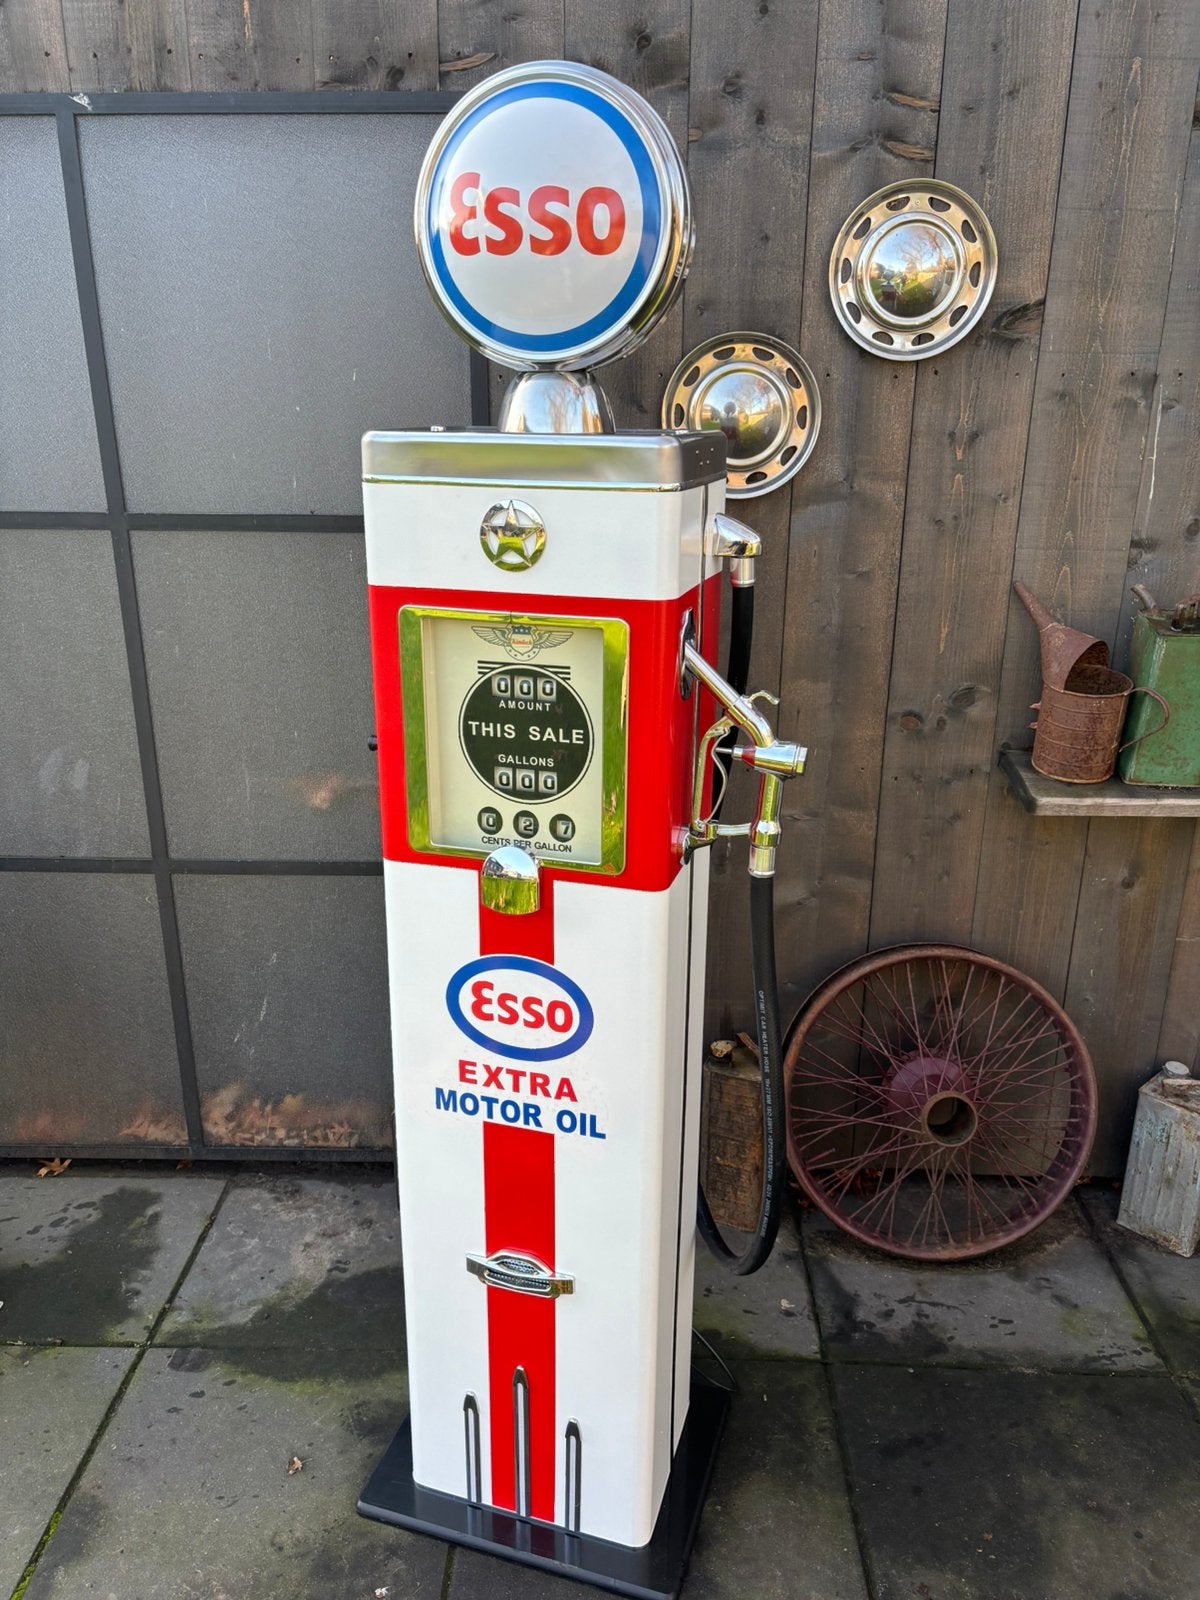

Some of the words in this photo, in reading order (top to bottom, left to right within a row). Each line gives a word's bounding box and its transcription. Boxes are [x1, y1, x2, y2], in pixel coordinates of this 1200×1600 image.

[498, 700, 551, 711] AMOUNT
[467, 721, 516, 739] THIS
[528, 726, 584, 744] SALE
[498, 754, 555, 767] GALLONS
[481, 836, 511, 846] CENTS
[513, 839, 532, 848] PER
[534, 841, 572, 853] GALLON
[761, 1031, 769, 1055] HEATER
[458, 1059, 578, 1102] EXTRA
[435, 1087, 543, 1128] MOTOR
[556, 1109, 607, 1139] OIL
